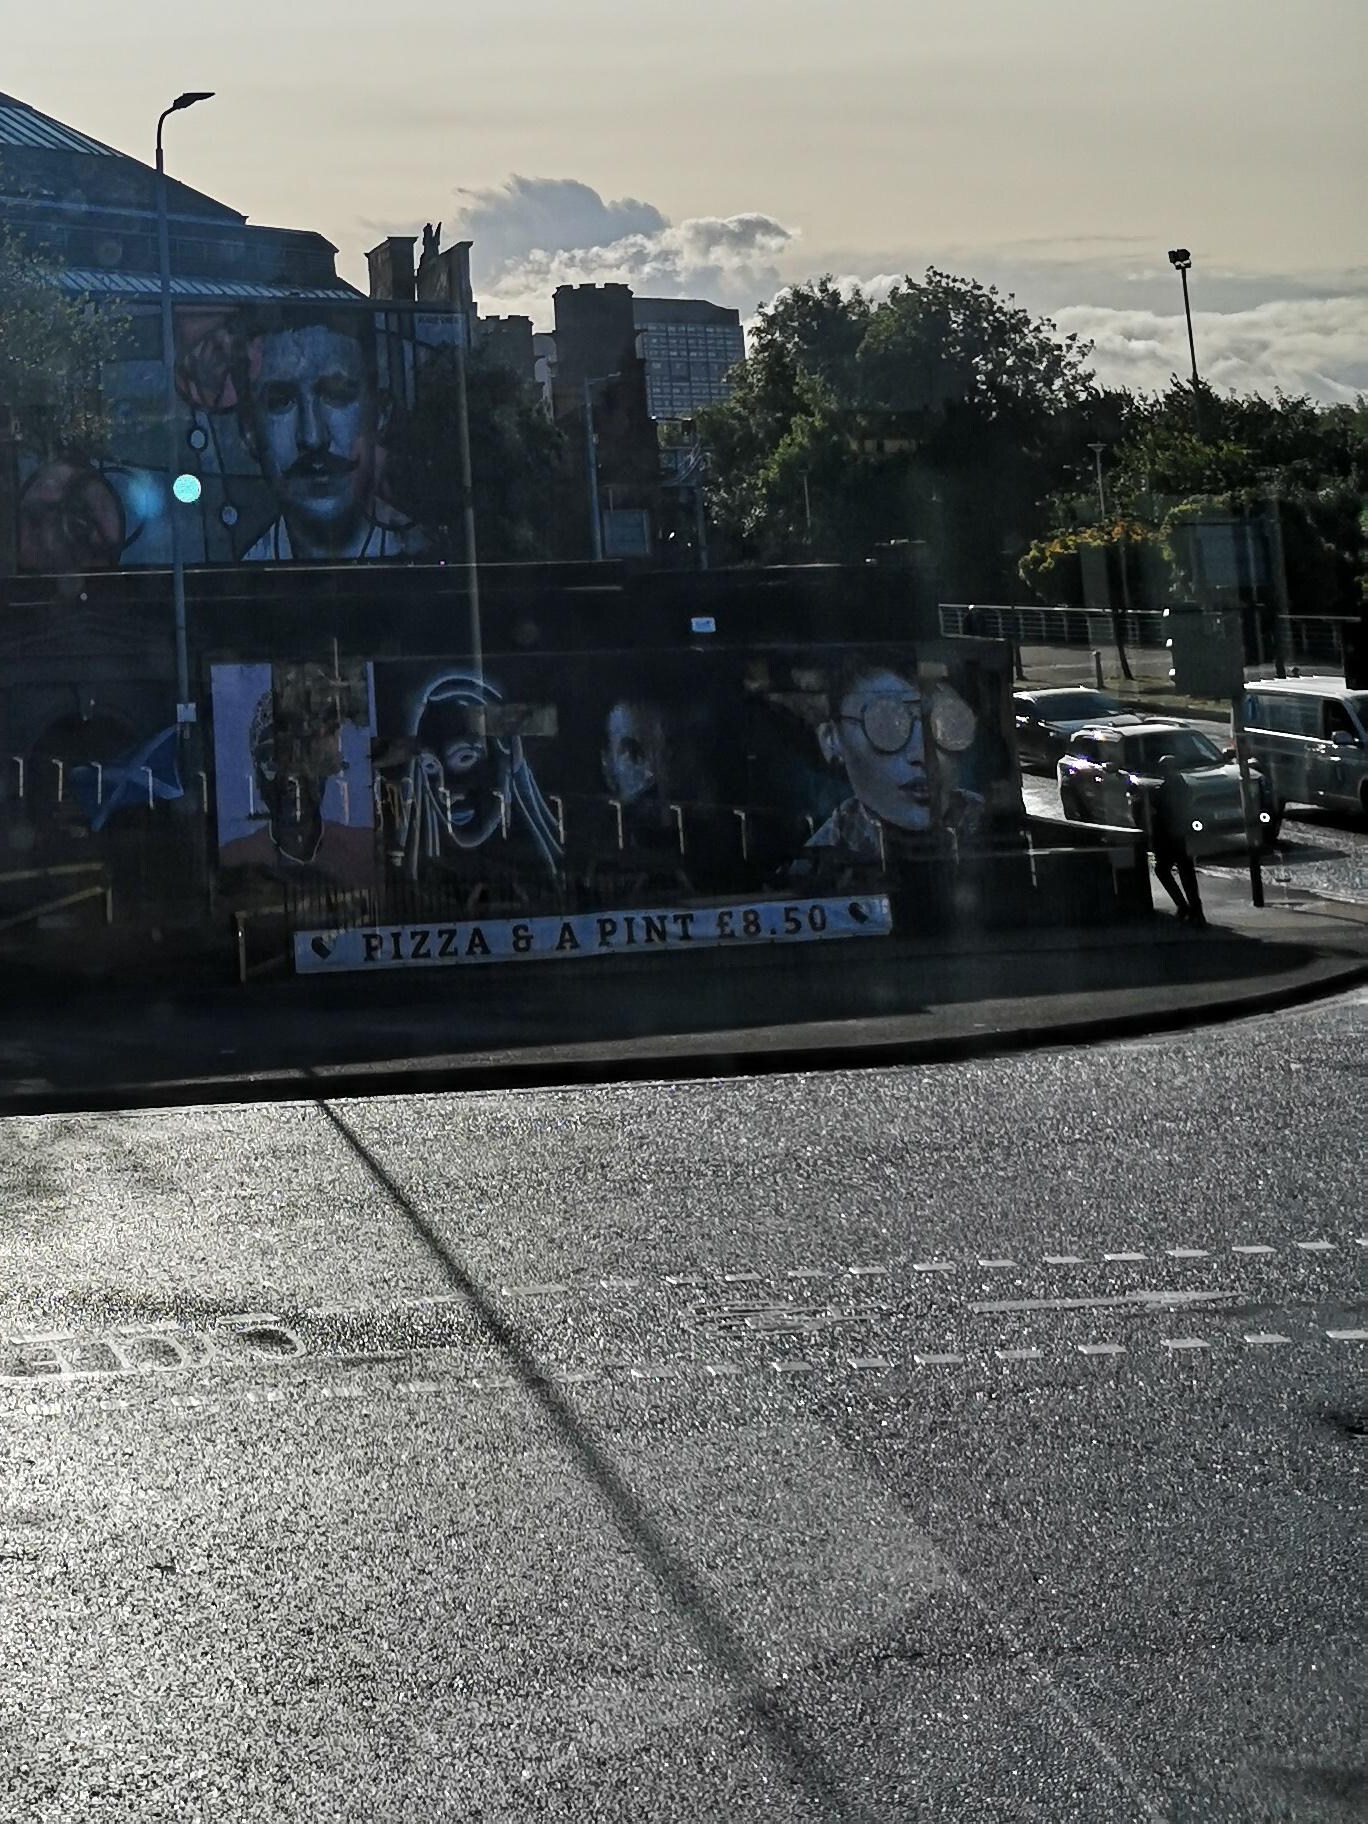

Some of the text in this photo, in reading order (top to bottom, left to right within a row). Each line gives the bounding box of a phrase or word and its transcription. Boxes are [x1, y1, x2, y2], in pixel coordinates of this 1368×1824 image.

[363, 904, 827, 961] PIZZA & A PINT £8.50
